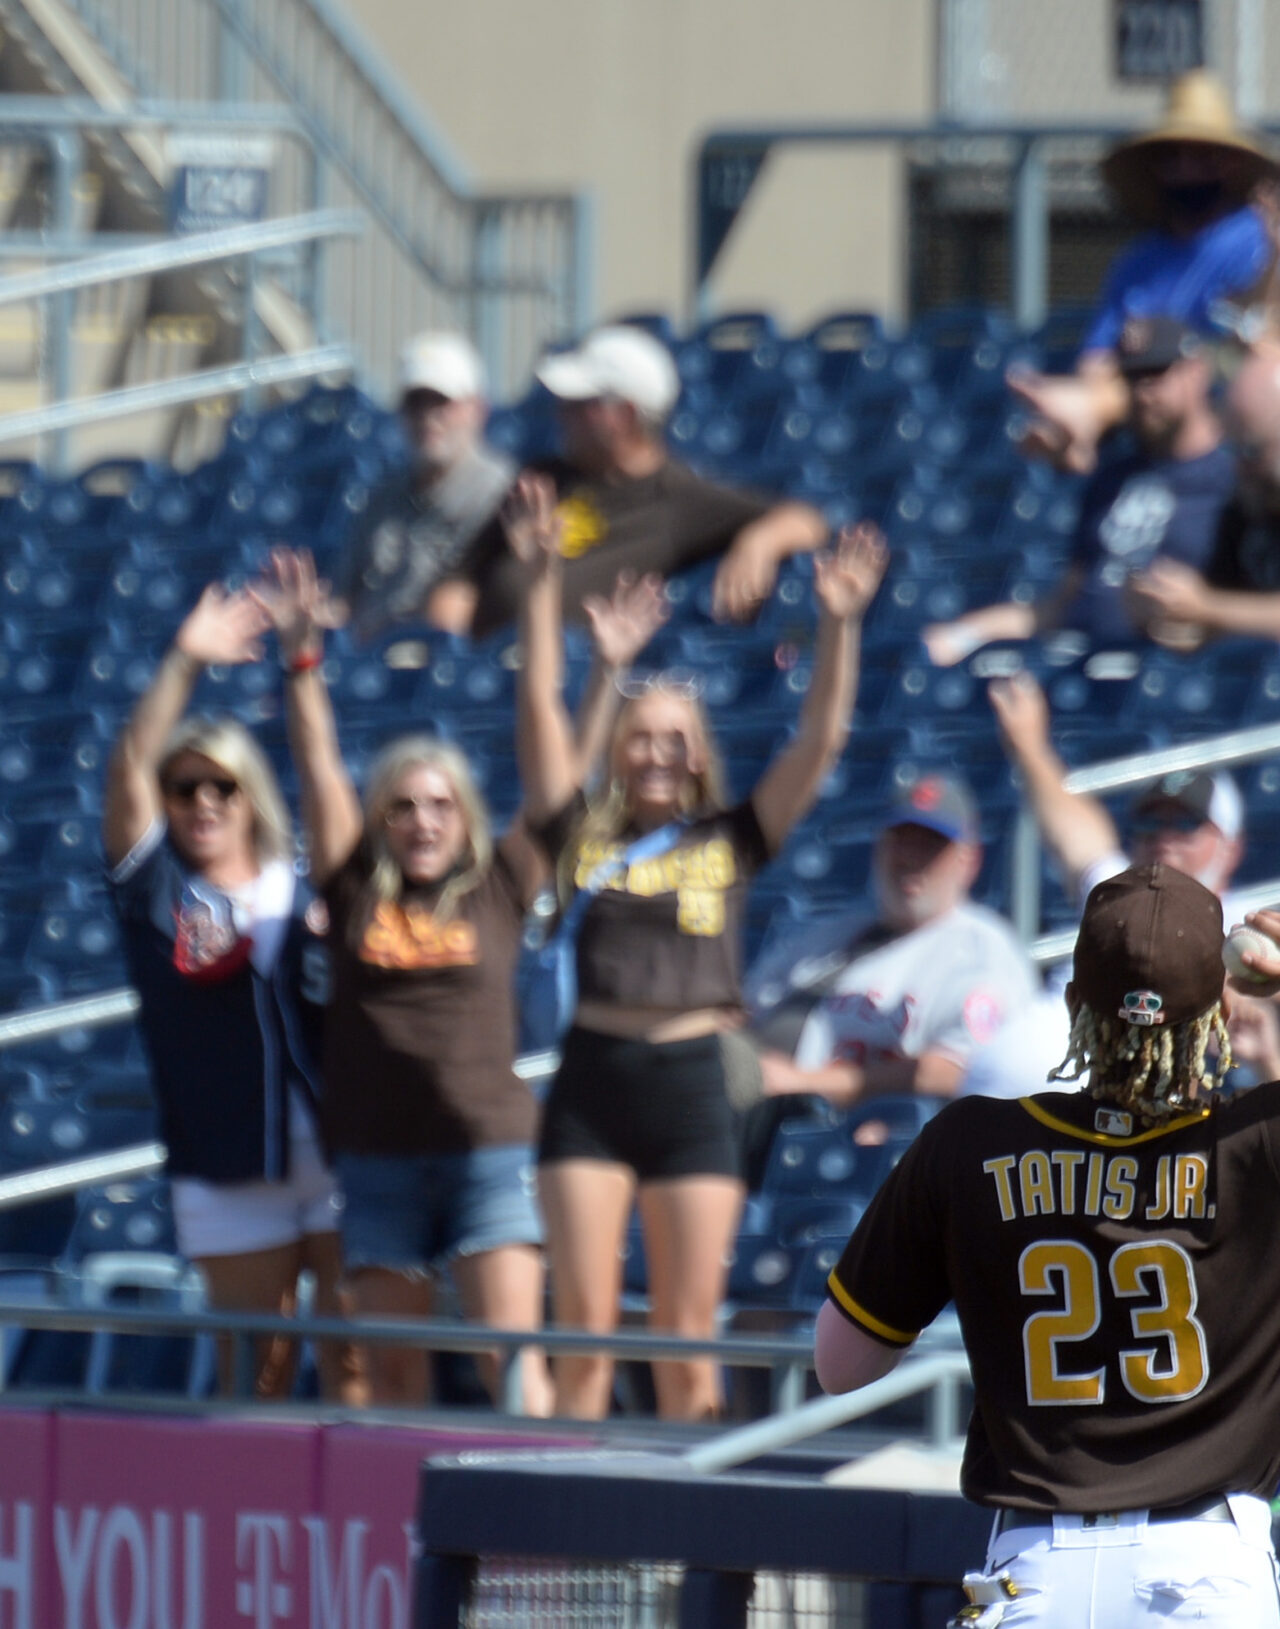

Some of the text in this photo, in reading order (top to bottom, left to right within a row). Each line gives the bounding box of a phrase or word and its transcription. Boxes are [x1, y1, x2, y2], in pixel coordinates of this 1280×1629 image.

[983, 1150, 1216, 1221] TATIS JR.
[1018, 1238, 1210, 1406] 23
[52, 1502, 205, 1629] YOU
